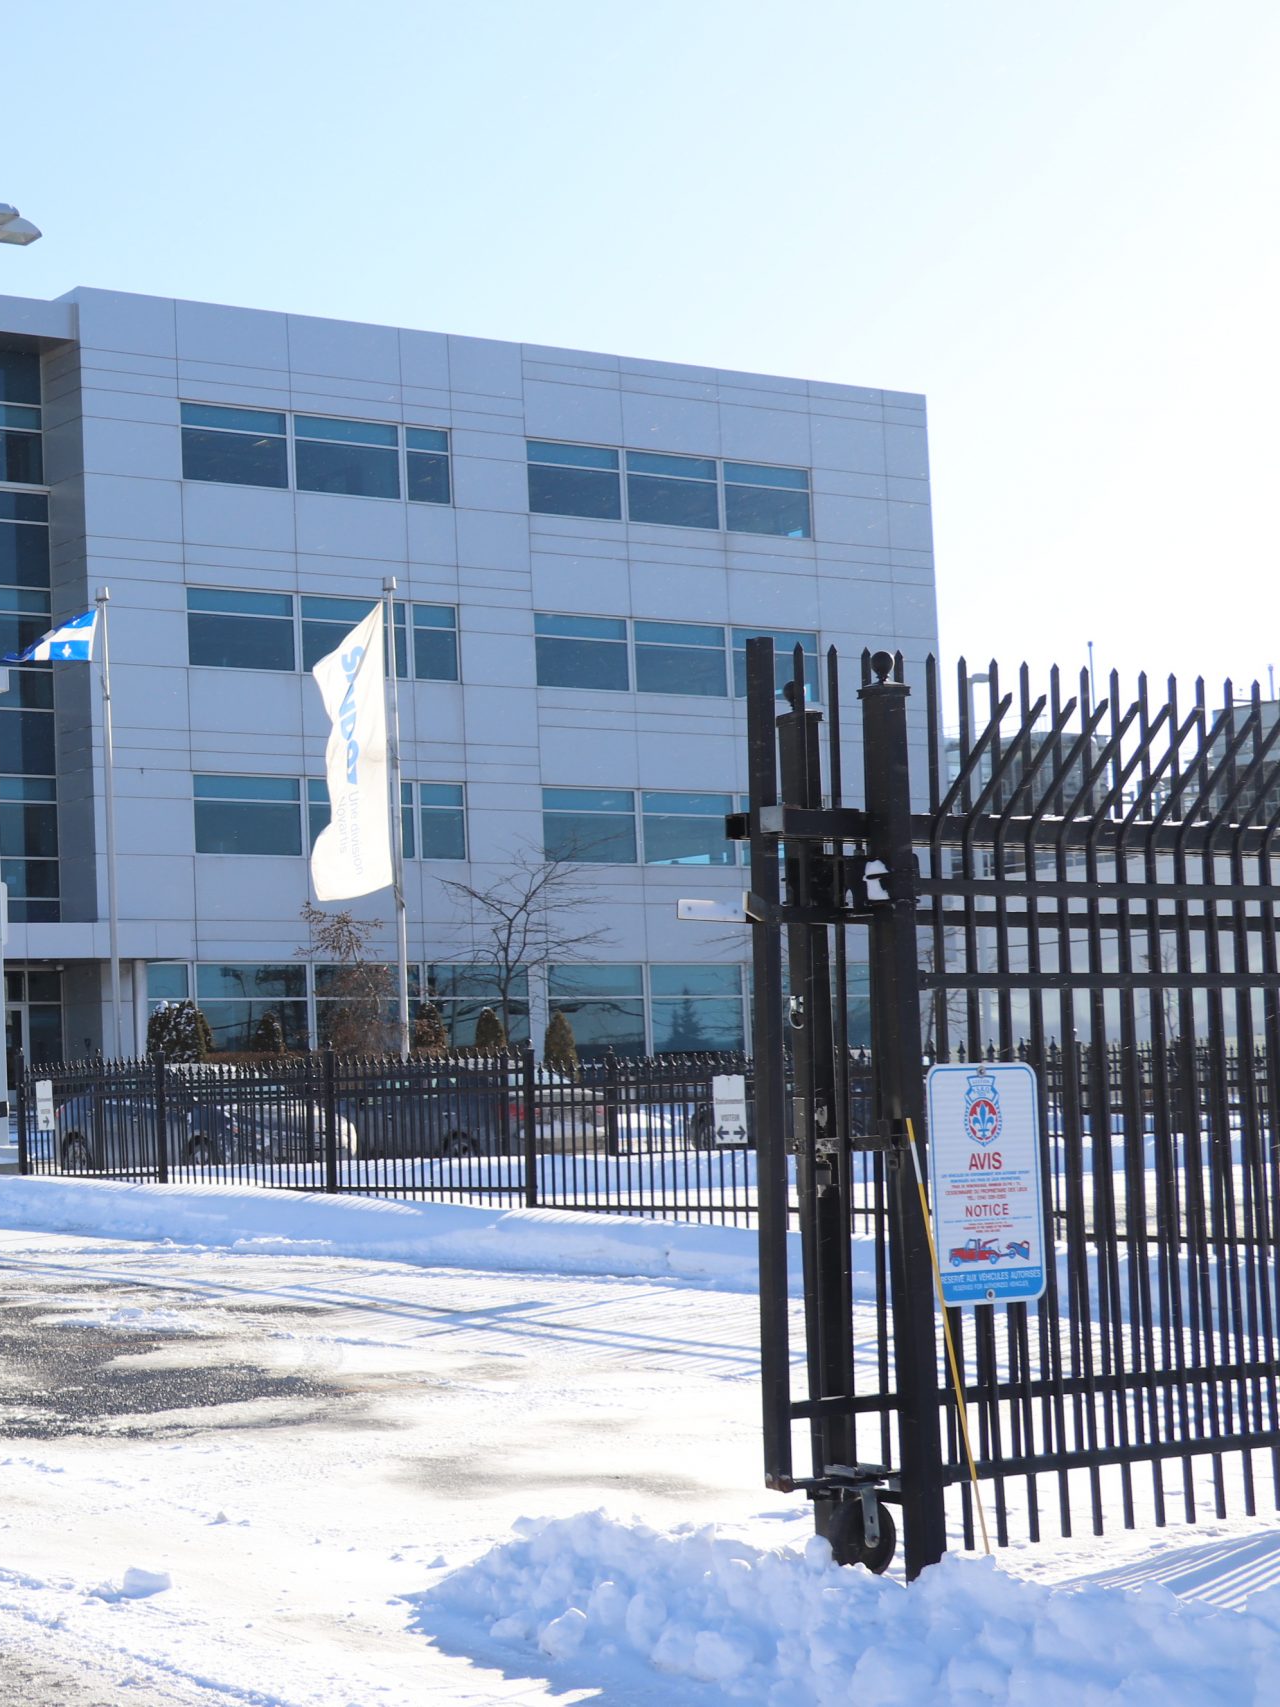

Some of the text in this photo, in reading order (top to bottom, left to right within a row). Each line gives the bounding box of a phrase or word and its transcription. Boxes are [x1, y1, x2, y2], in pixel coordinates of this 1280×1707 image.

[348, 790, 365, 876] Une division
[968, 1151, 1003, 1171] AVIS
[965, 1203, 1009, 1217] NOTICE
